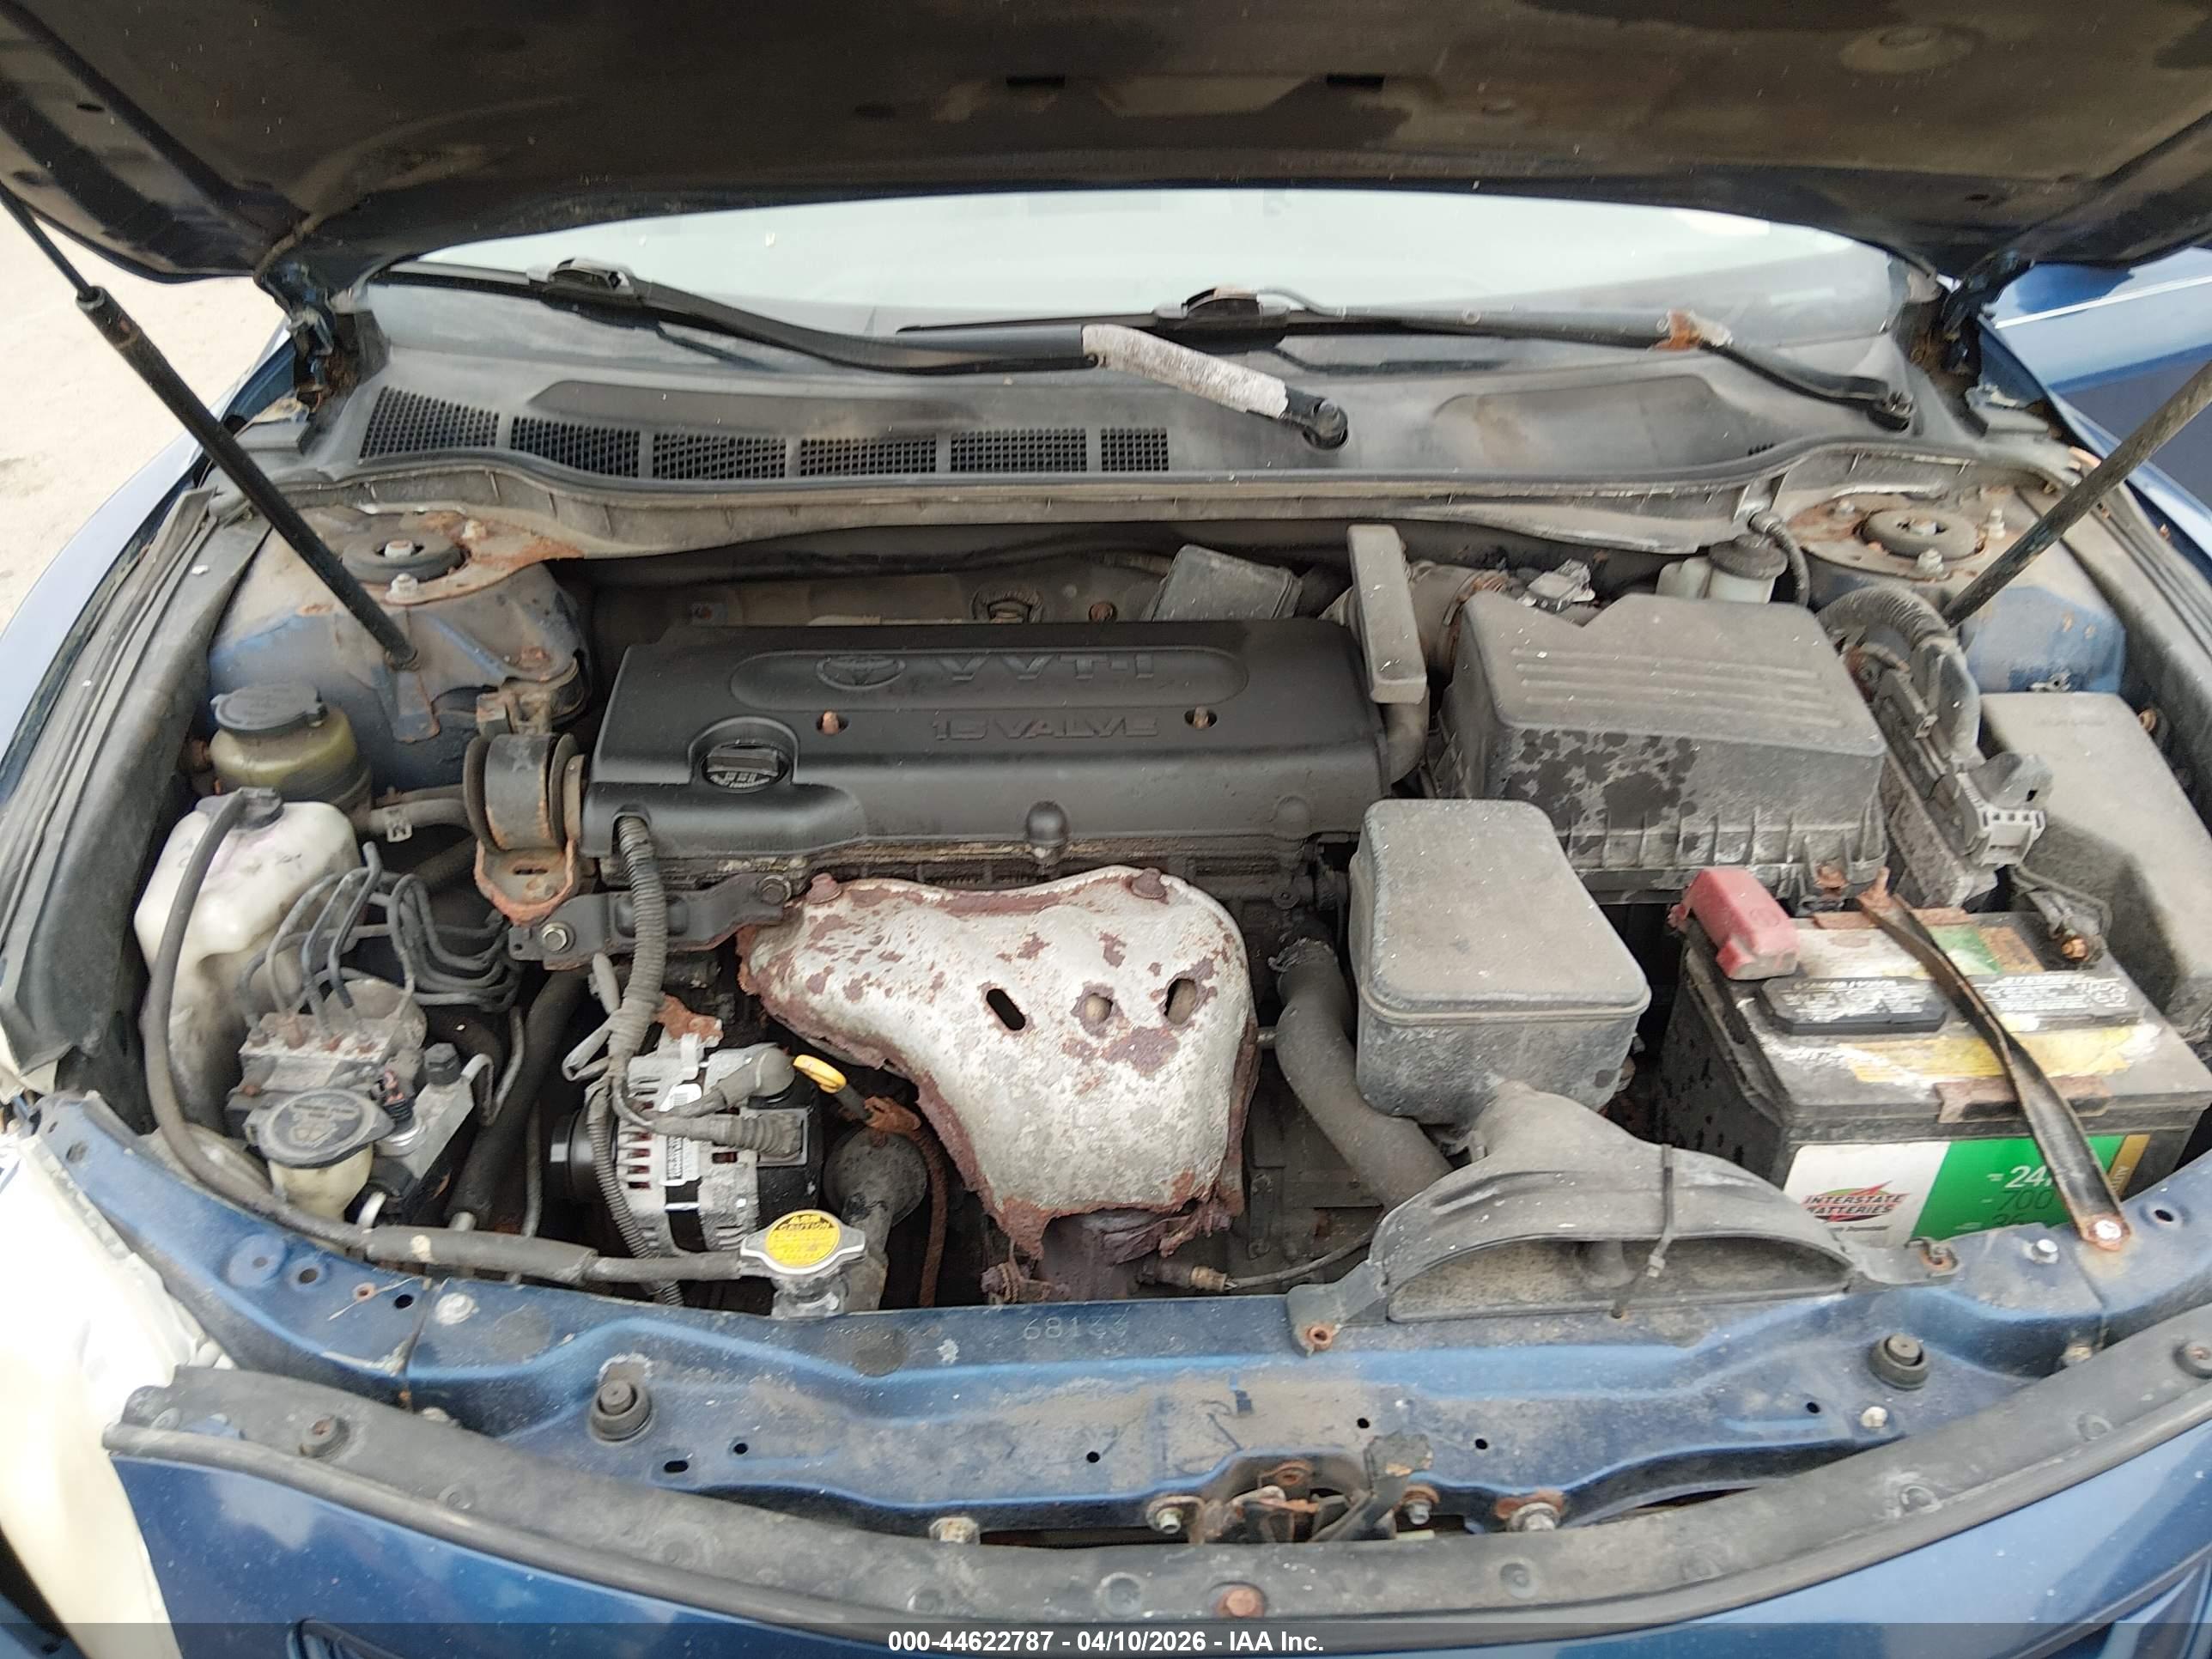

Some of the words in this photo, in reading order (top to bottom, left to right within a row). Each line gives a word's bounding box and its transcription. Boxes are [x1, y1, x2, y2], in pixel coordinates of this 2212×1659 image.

[996, 715, 1159, 739] VALVE
[1805, 1194, 1904, 1205] INTERSTATE
[1997, 1188, 2055, 1210] 700
